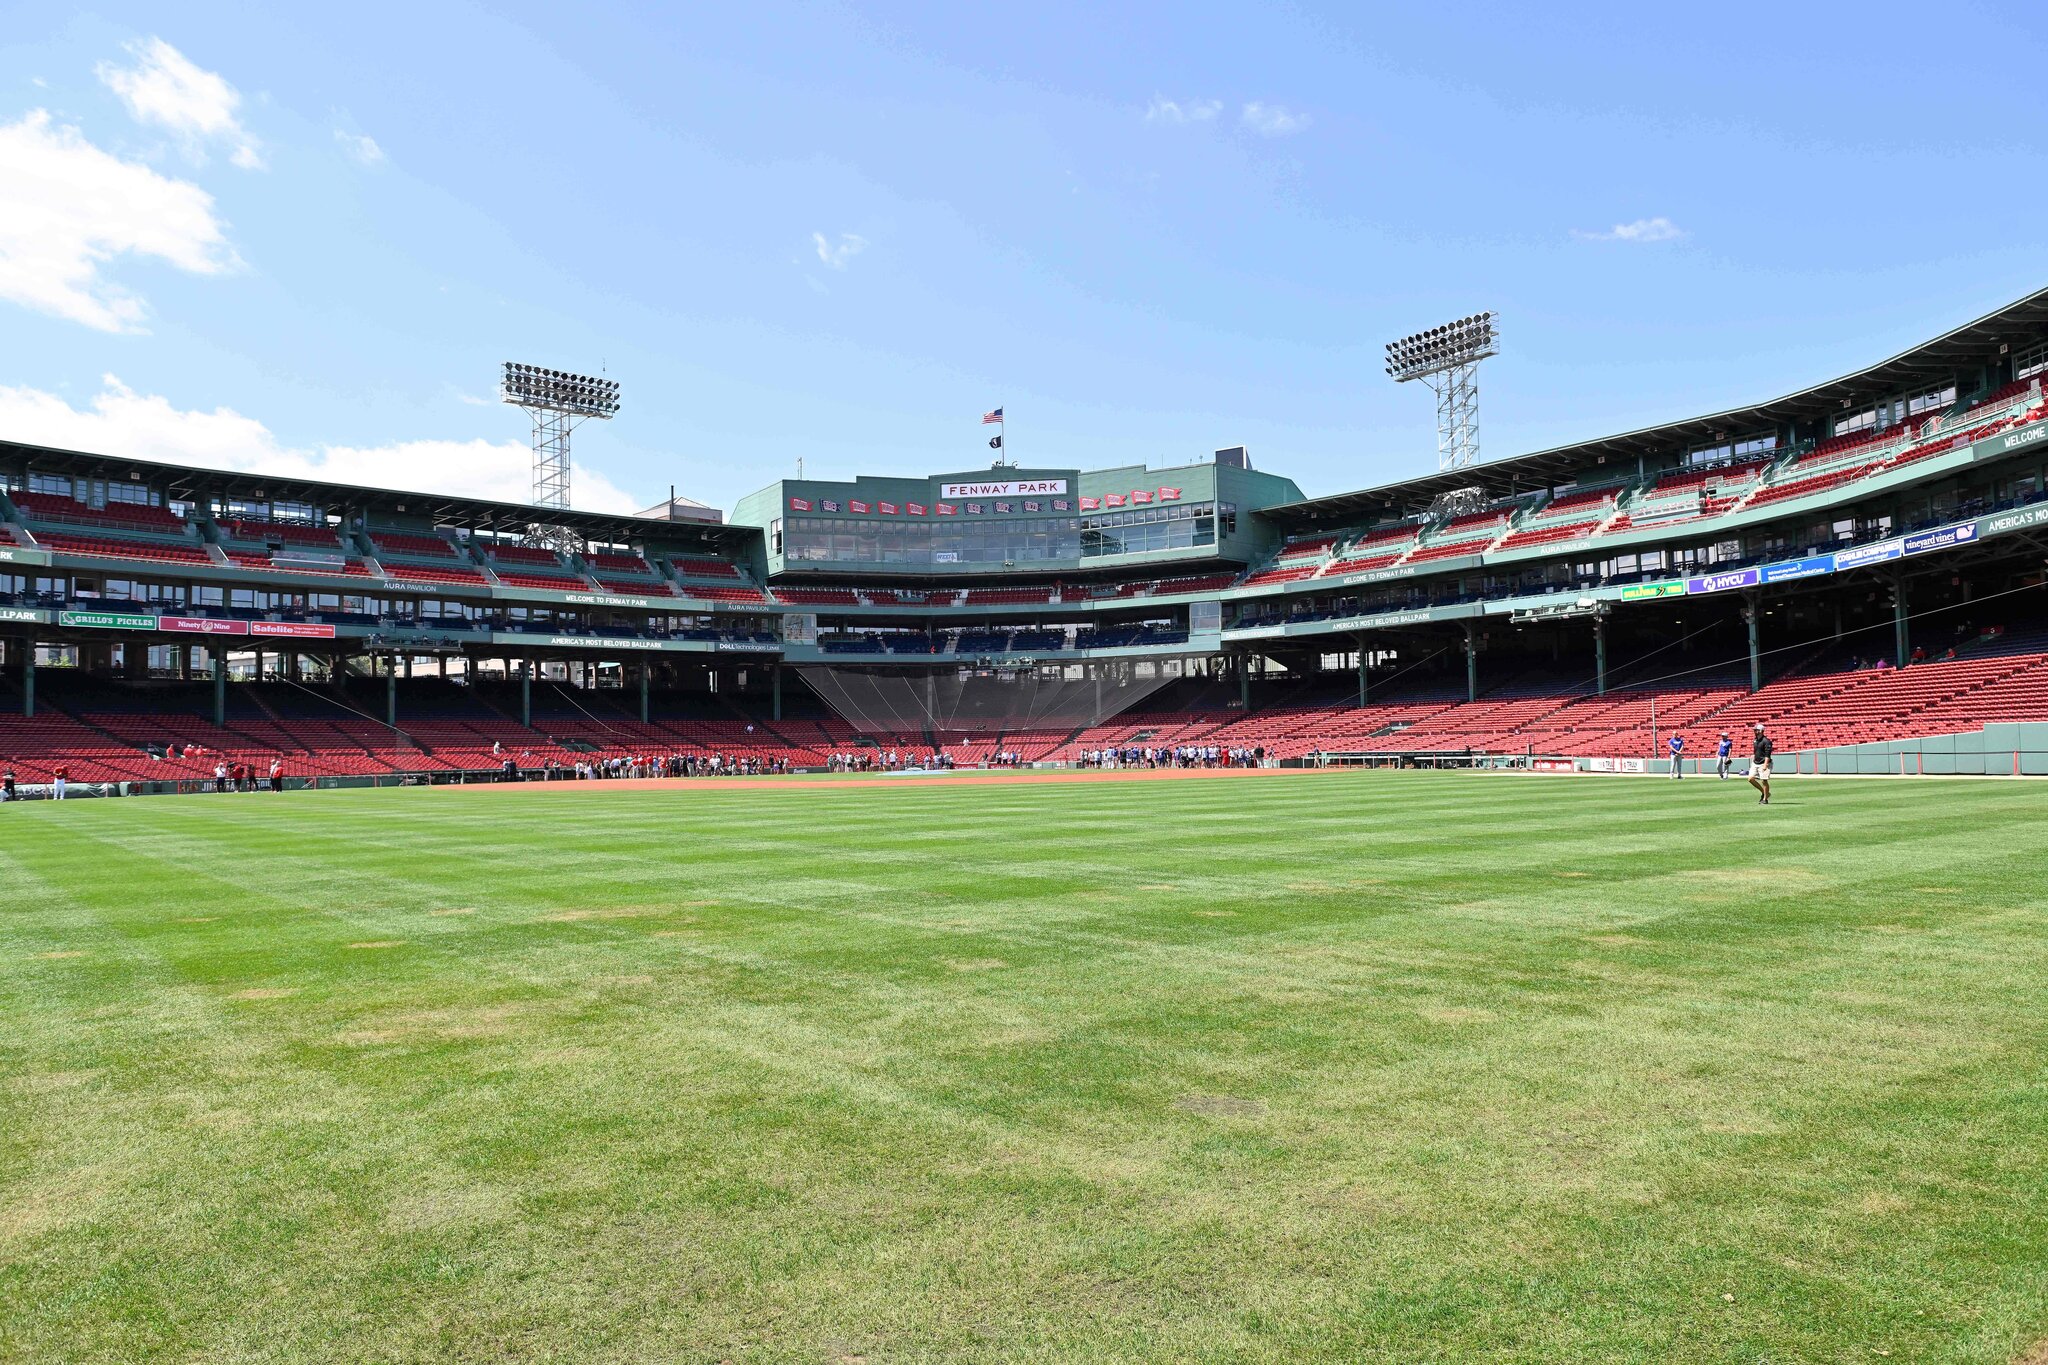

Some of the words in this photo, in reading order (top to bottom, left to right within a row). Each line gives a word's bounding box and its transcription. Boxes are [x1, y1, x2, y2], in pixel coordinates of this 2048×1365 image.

[2004, 426, 2046, 448] WELCOME
[949, 484, 1009, 495] FENWAY
[1018, 482, 1058, 493] PARK
[1988, 512, 2033, 532] AMERICA'S
[2035, 509, 2048, 521] MO
[1905, 534, 1936, 549] vineyard
[1935, 531, 1955, 543] vines
[0, 552, 13, 560] RK
[1343, 574, 1367, 584] WELCOME
[1376, 569, 1398, 579] FENWAY
[1399, 567, 1415, 575] PARK
[1717, 574, 1744, 588] HYCU
[406, 583, 437, 592] PAVILION
[565, 594, 594, 604] WELCOME
[596, 596, 604, 604] TO
[605, 597, 630, 606] FENWAY
[75, 615, 114, 625] GRILLO'S
[116, 617, 153, 627] PICKLES
[177, 621, 201, 630] Ninety
[213, 623, 231, 631] Nine
[1332, 620, 1359, 630] AMERICA'S
[1360, 619, 1374, 628] MOST
[1375, 616, 1399, 625] BELOVED
[1400, 613, 1430, 623] BALLPARK
[253, 624, 294, 634] Safelite
[551, 637, 584, 646] AMERICA'S
[603, 639, 631, 647] BELOVED
